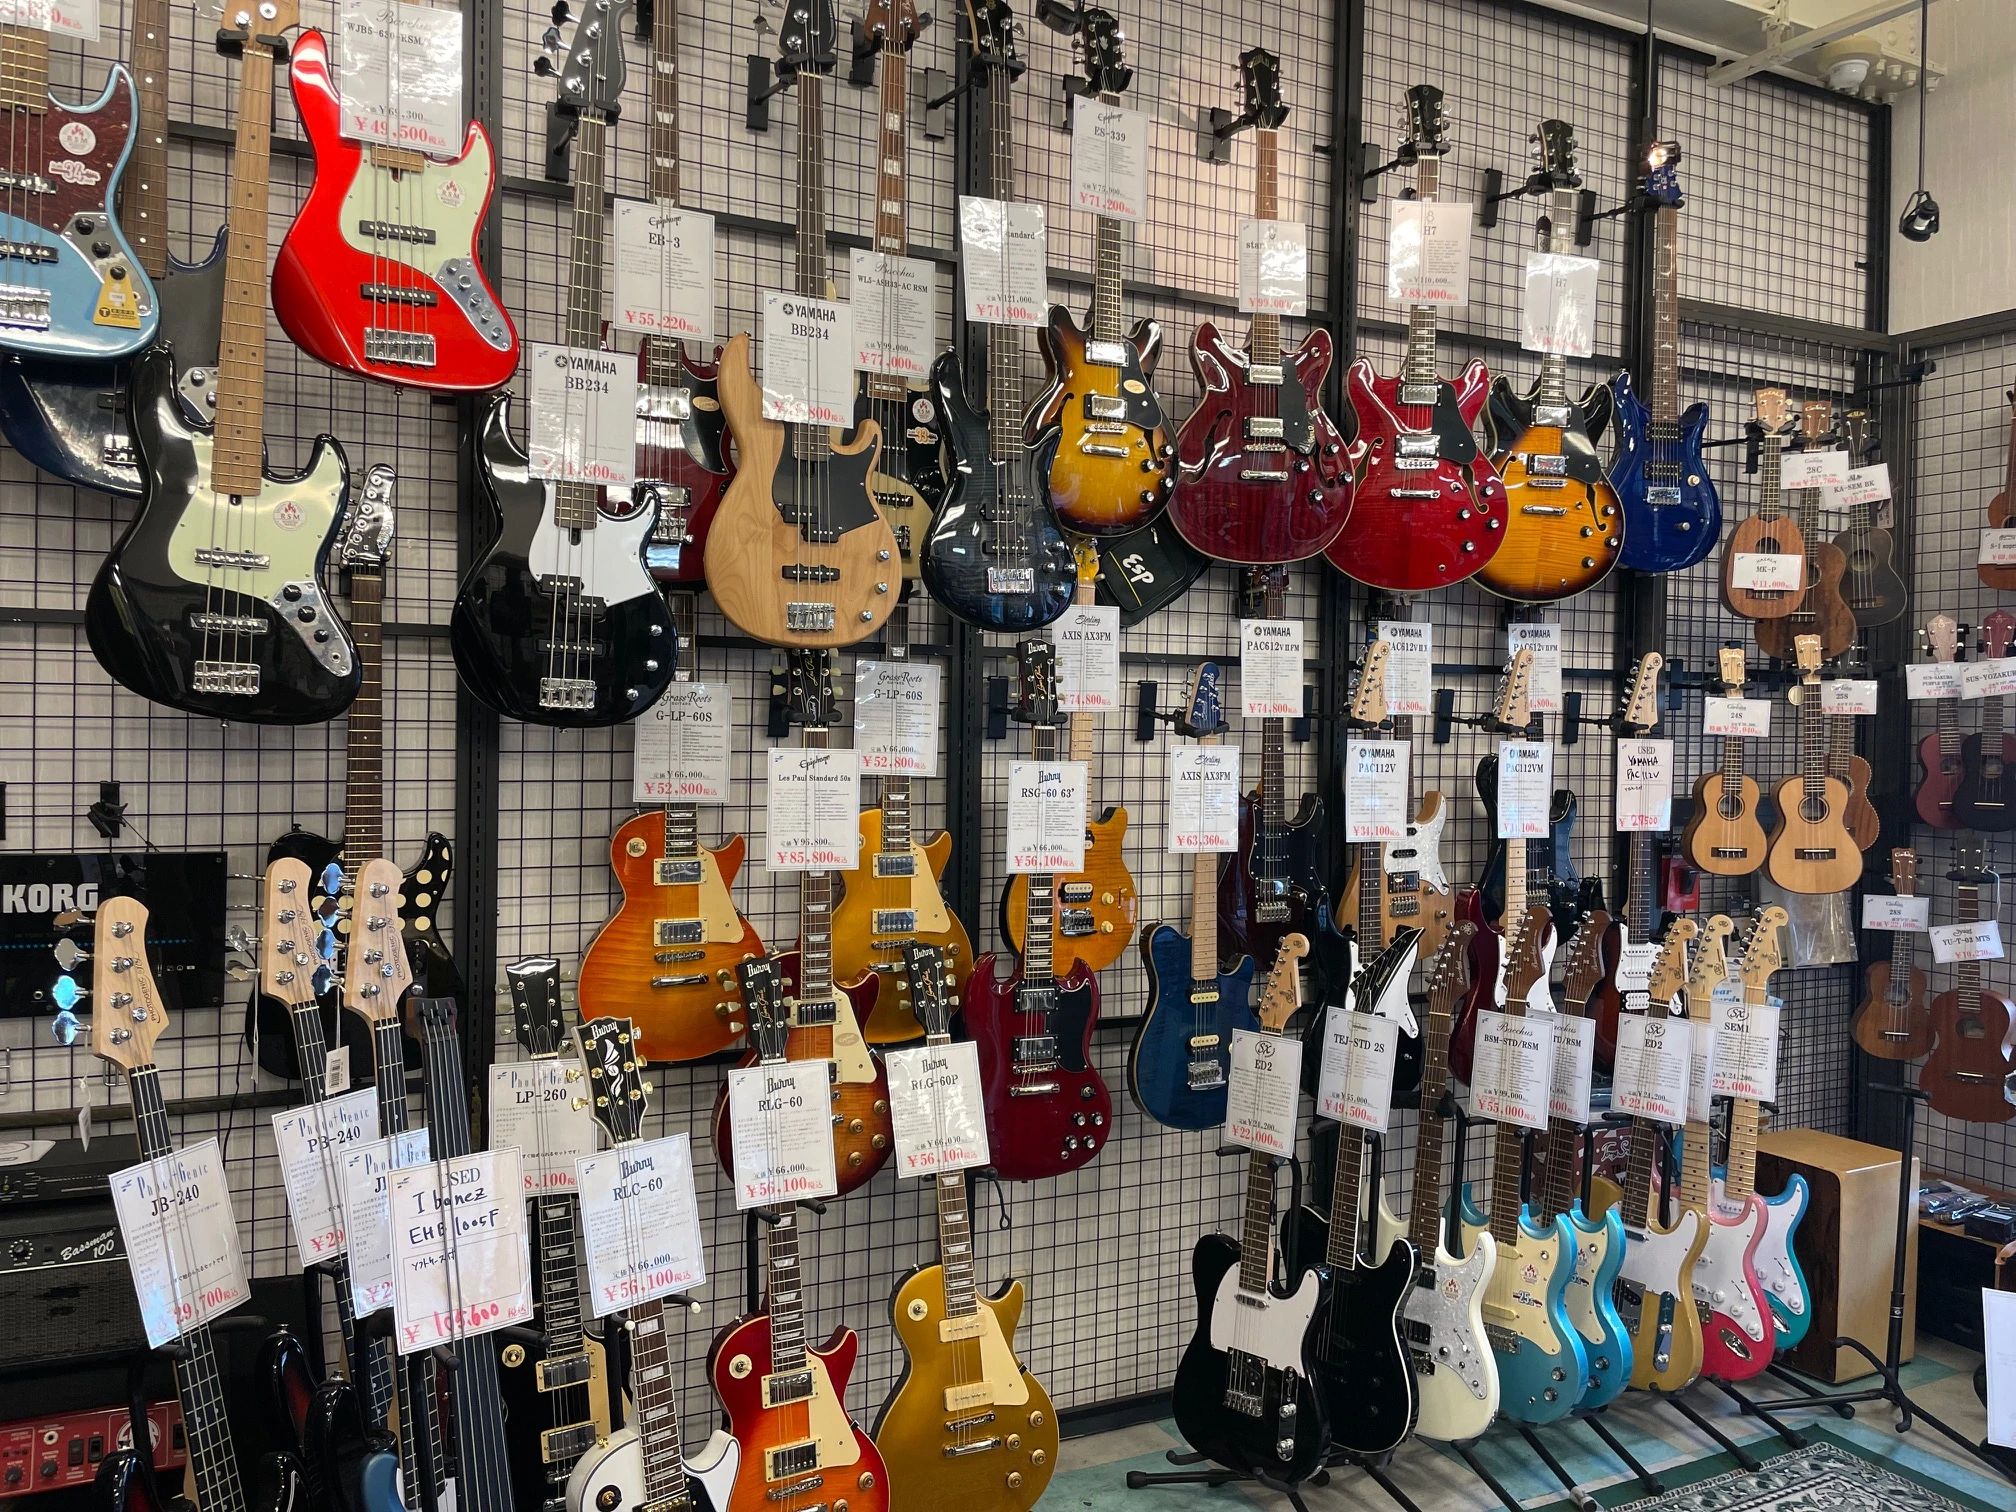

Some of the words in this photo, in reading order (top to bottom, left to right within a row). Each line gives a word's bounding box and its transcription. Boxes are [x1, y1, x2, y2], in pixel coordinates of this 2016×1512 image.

[1094, 126, 1126, 143] ES-339
[648, 214, 682, 229] Epiphone
[1424, 226, 1437, 235] H7
[648, 232, 681, 248] EB-3
[913, 283, 928, 293] RSM
[625, 310, 687, 331] ¥55,220
[795, 305, 836, 322] YAMAHA
[791, 323, 830, 340] BB234
[569, 356, 617, 375] YAMAHA
[860, 351, 912, 371] ¥77,000
[565, 376, 609, 394] BB234
[1122, 553, 1155, 584] ESP
[1062, 630, 1082, 640] AXIS
[1084, 631, 1111, 641] AX3FM
[1262, 627, 1291, 637] YAMAHA
[1398, 628, 1423, 638] YAMAHA
[1528, 629, 1551, 638] YAMAHA
[874, 688, 923, 701] G-LP-60S
[656, 710, 712, 722] G-LP-60S
[1368, 748, 1395, 758] YAMAHA
[1637, 746, 1656, 755] USED
[798, 754, 830, 771] Epiphone
[863, 755, 914, 769] ¥52,800
[1358, 763, 1397, 773] PAC112V
[1628, 755, 1659, 766] YAMAHA
[667, 771, 703, 779] ¥66,000
[809, 774, 839, 782] Standard
[1180, 771, 1201, 781] AXIS
[1204, 771, 1231, 781] AX3FM
[644, 782, 704, 796] ¥52,800
[1021, 788, 1057, 798] RSG-60
[777, 851, 834, 864] ¥85,800
[1014, 855, 1063, 867] ¥56,100
[2, 883, 99, 914] KORG
[1724, 1022, 1750, 1033] SEM1
[1333, 1033, 1371, 1050] TEJ-STD
[1374, 1043, 1385, 1053] 2S
[1484, 1034, 1539, 1051] BSM-STD/RSM
[1645, 1038, 1663, 1050] ED2
[1255, 1059, 1273, 1072] ED2
[767, 1076, 795, 1094] Burny
[912, 1074, 959, 1090] RLG-60P
[516, 1088, 567, 1104] LP-260
[758, 1096, 803, 1112] RLG-60
[1478, 1099, 1524, 1117] ¥55,000
[1619, 1095, 1664, 1114] ¥22,000
[308, 1125, 361, 1153] PB-240
[1231, 1124, 1273, 1145] ¥22,000
[907, 1149, 964, 1168] ¥56,100
[621, 1157, 655, 1180] Burny
[768, 1163, 805, 1176] ¥66,000
[441, 1167, 481, 1188] USED
[612, 1177, 663, 1201] RLC-60
[745, 1177, 807, 1198] ¥56,100
[151, 1184, 200, 1216] JB-240
[61, 1229, 114, 1261] Bassman
[93, 1239, 115, 1259] 100
[628, 1253, 671, 1273] ¥66,000
[604, 1269, 674, 1302] ¥56,100
[404, 1324, 420, 1344] ¥
